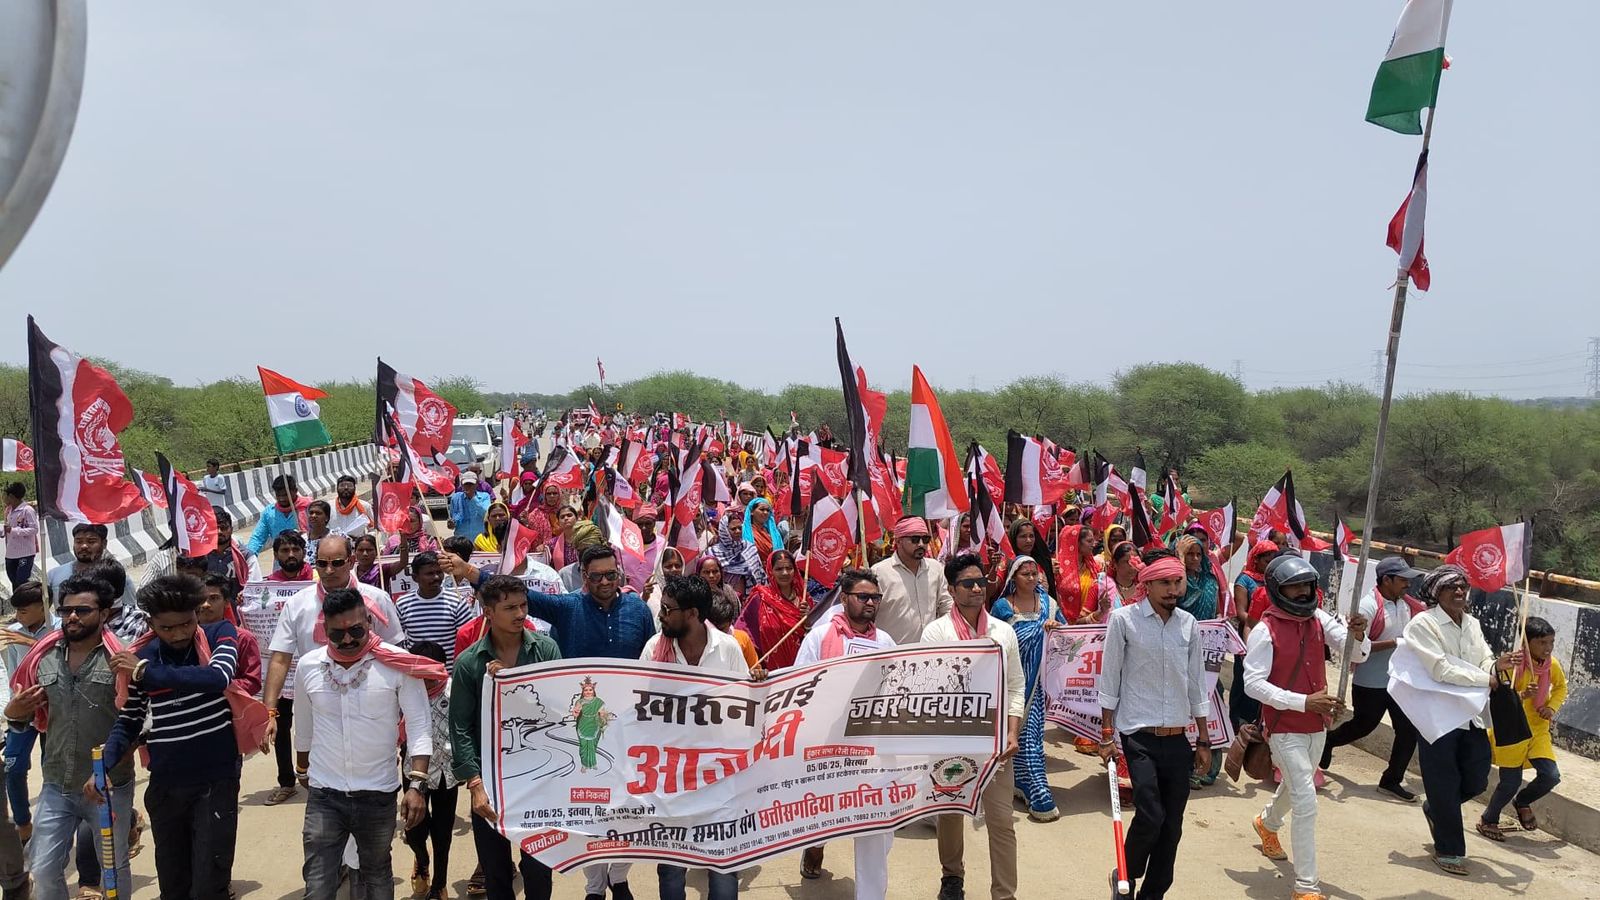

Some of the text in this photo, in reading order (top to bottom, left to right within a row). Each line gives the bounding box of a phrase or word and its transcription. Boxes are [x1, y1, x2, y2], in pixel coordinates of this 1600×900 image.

[633, 670, 828, 727] खारून दाई
[850, 692, 992, 719] जबर पदयात्रा
[807, 760, 842, 773] 05/06/25,
[524, 807, 566, 819] 01/06/25,
[692, 819, 739, 842] समाज
[757, 792, 834, 830] छत्तीसगढ़िया
[886, 780, 917, 804] सेना
